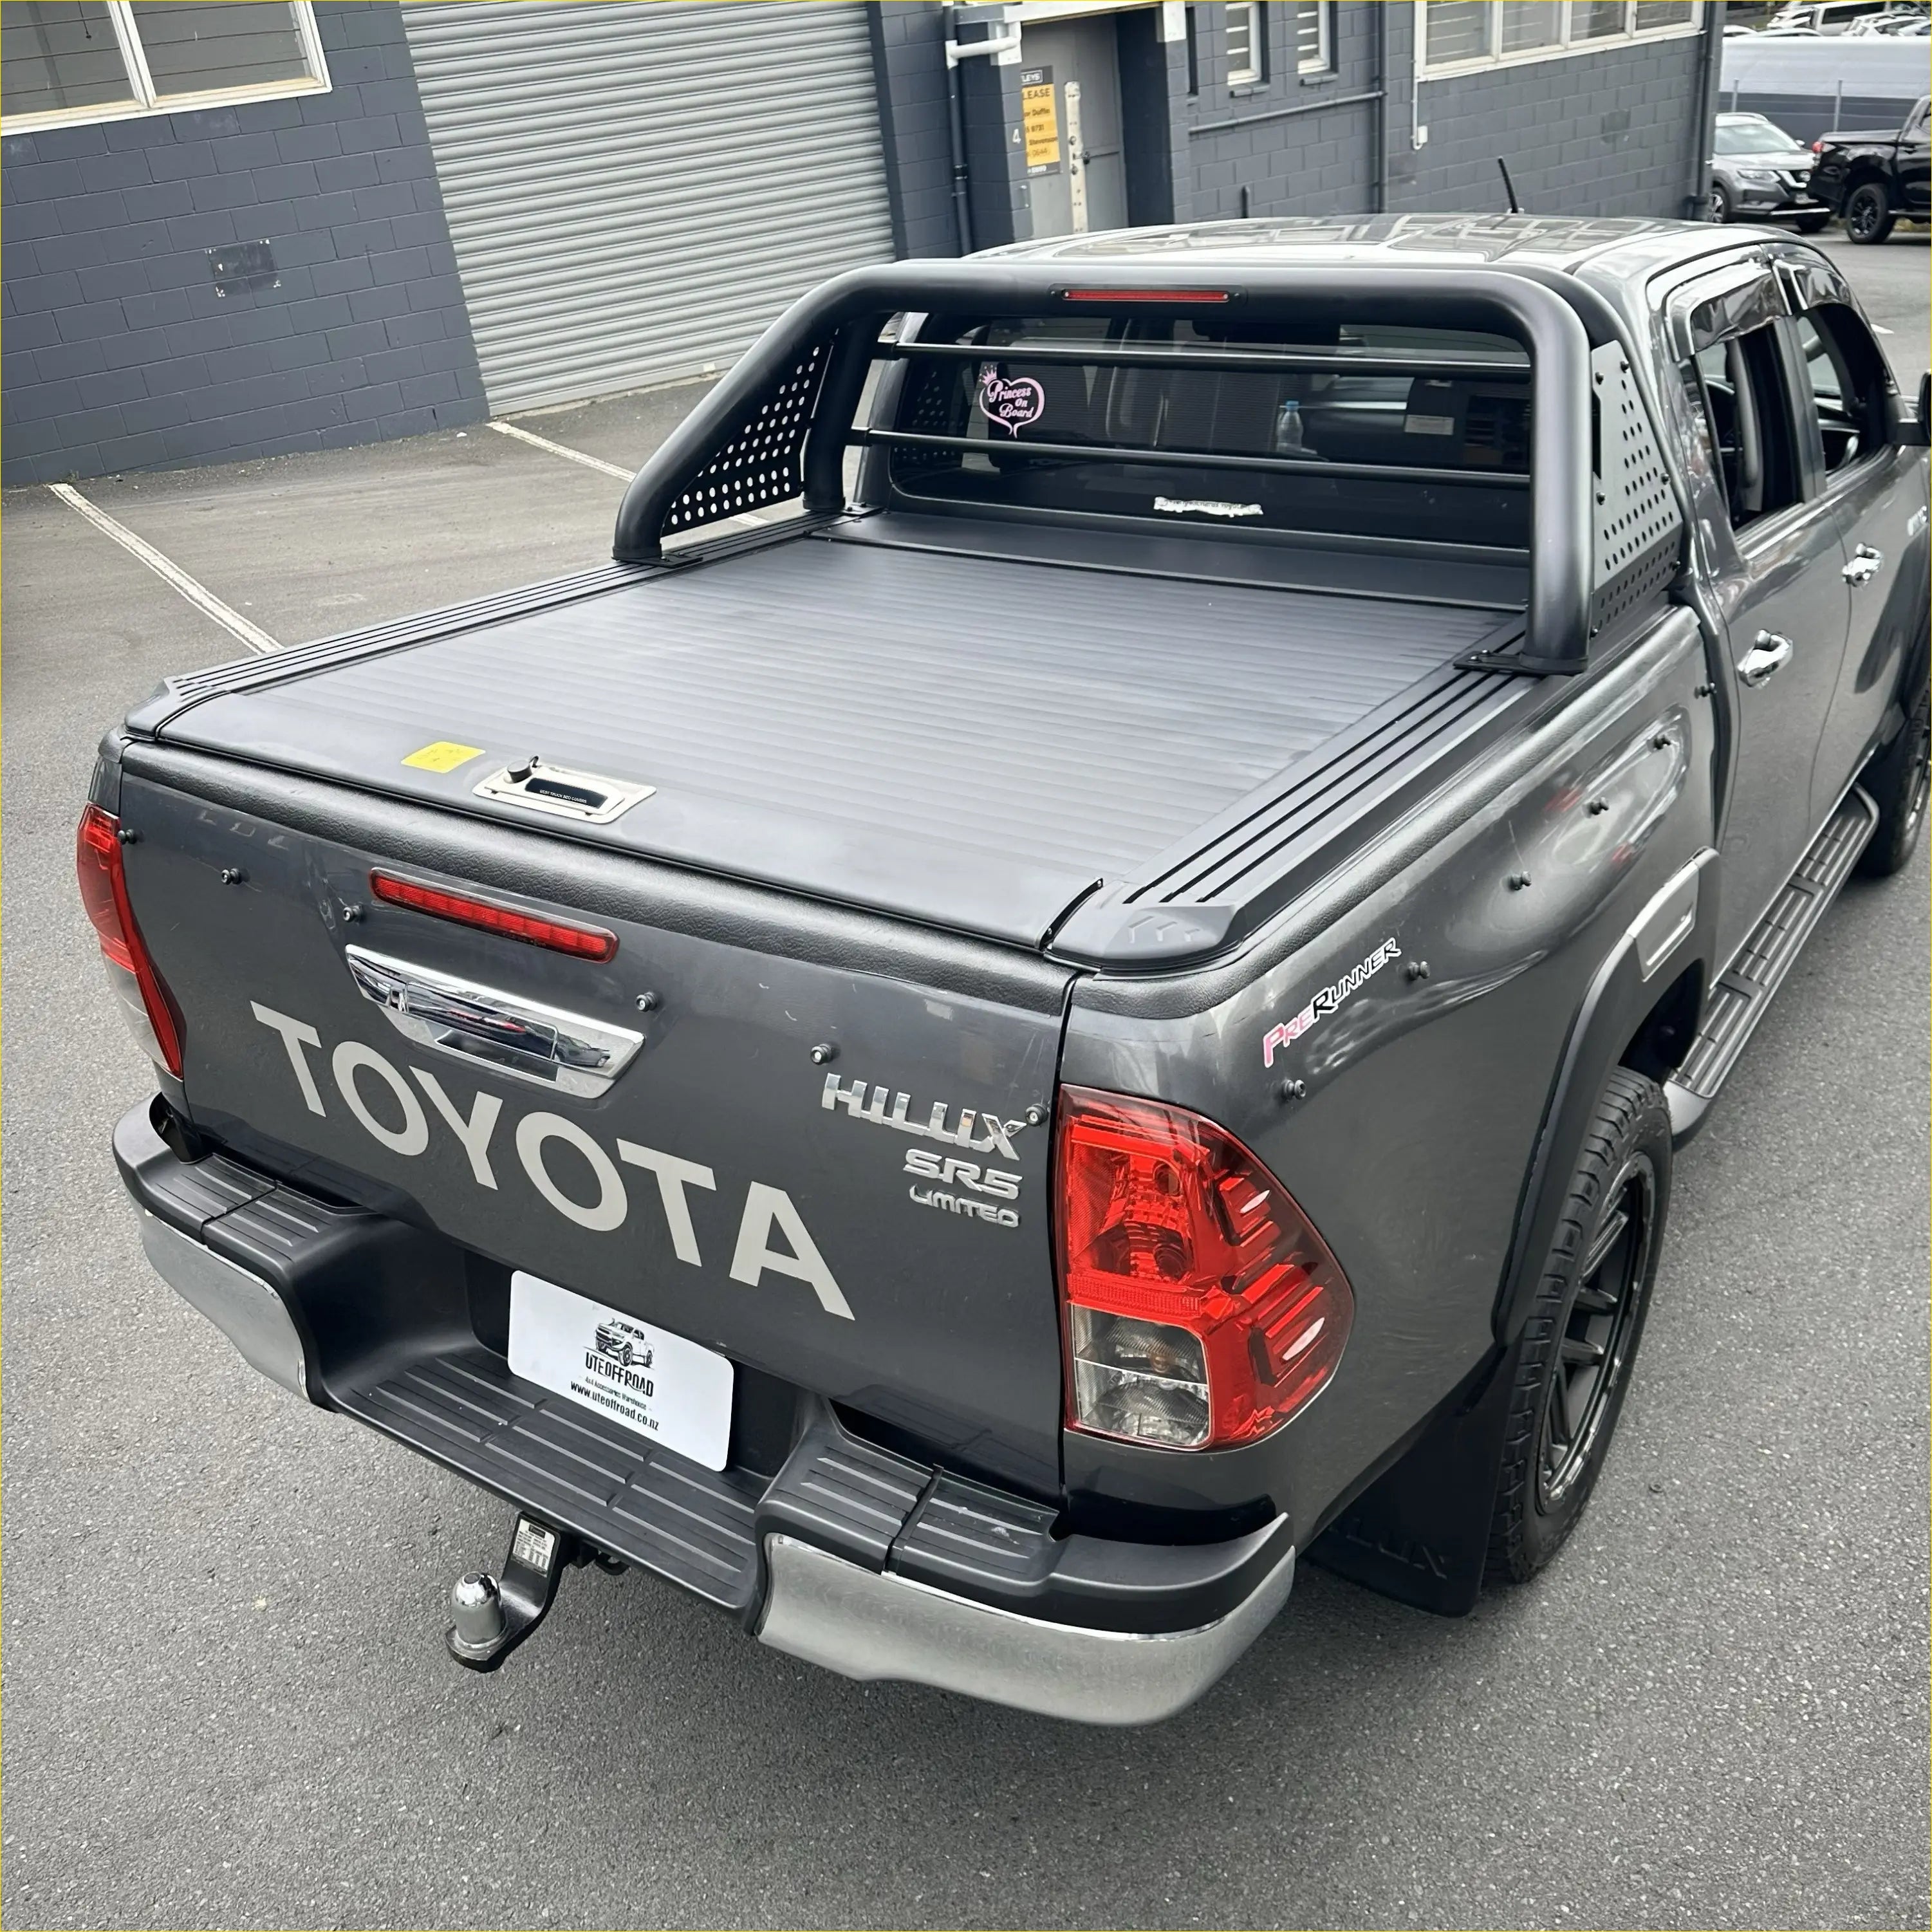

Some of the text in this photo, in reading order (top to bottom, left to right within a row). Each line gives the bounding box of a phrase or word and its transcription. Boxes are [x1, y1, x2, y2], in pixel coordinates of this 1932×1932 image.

[1012, 128, 1021, 144] 4
[987, 380, 1032, 403] Princess
[999, 403, 1034, 418] Board
[1015, 398, 1028, 407] On
[822, 1073, 1027, 1160] HILUX
[250, 1001, 856, 1321] TOYOTA
[903, 1148, 1023, 1200] SR5
[909, 1184, 1019, 1227] LIMITED
[585, 1376, 647, 1410] 4x4 Accessories Warehouse
[586, 1351, 654, 1397] UTEOFFROAD
[571, 1381, 659, 1431] www.uteoffroad.co.nz
